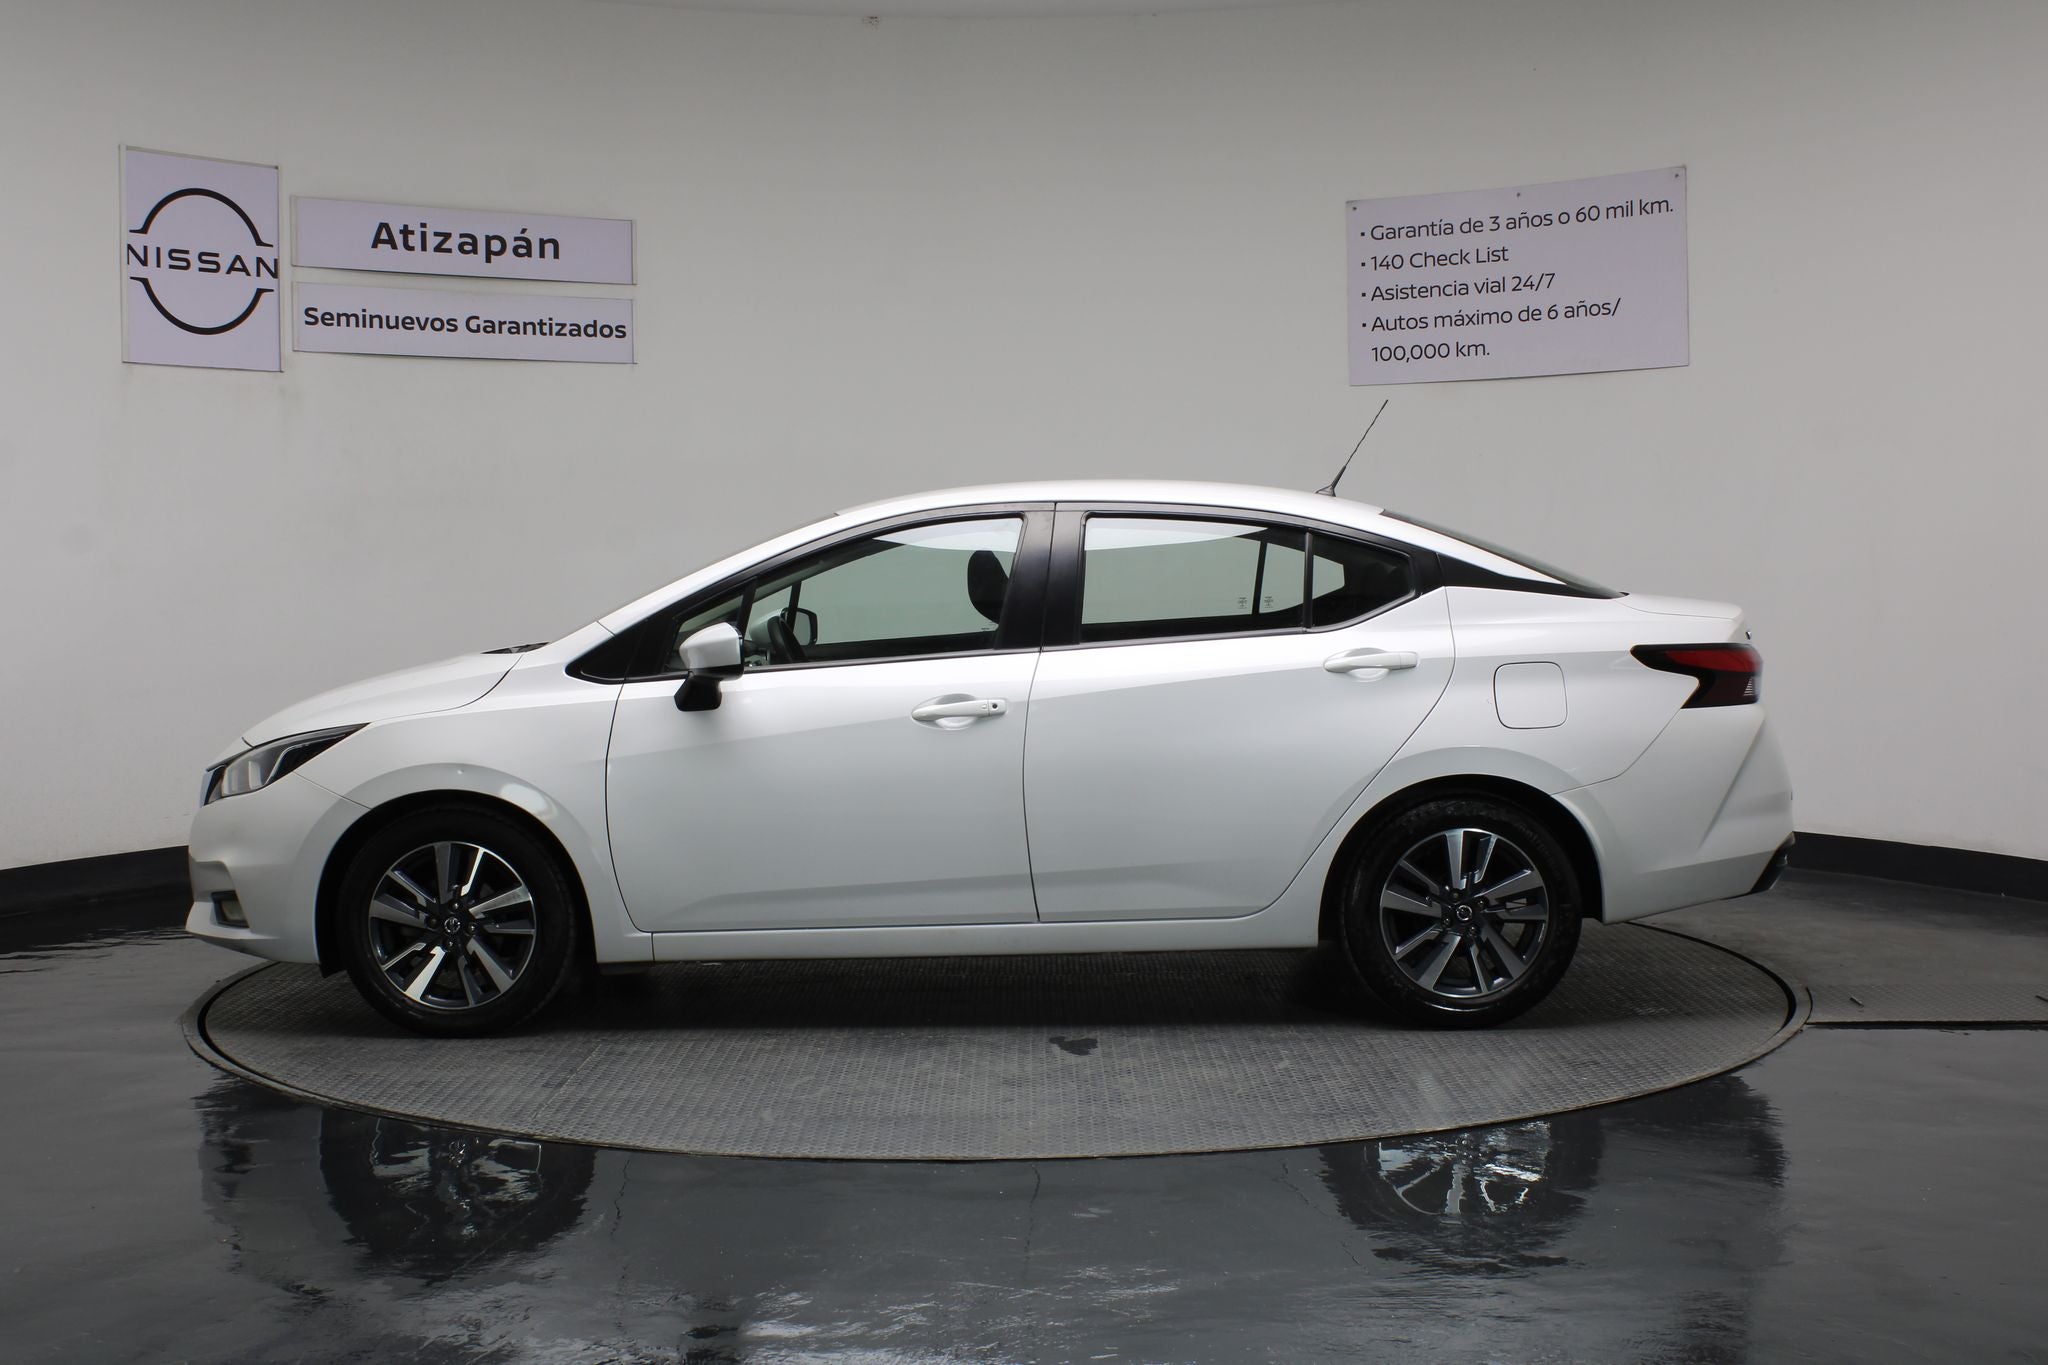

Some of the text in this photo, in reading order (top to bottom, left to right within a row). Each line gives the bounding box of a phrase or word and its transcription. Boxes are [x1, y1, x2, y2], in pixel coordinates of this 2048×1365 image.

[1370, 198, 1674, 241] Garantía de 3 años o 60 mil km.
[370, 221, 561, 264] Atizapán
[1370, 245, 1510, 272] 140 Check List
[126, 243, 280, 280] NISSAN
[1370, 272, 1556, 302] Asistencia vial 24/7
[304, 306, 628, 339] Seminuevos Garantizados
[1371, 297, 1622, 332] Autos máximo de 6 años/
[1371, 341, 1490, 364] 100,000 km.
